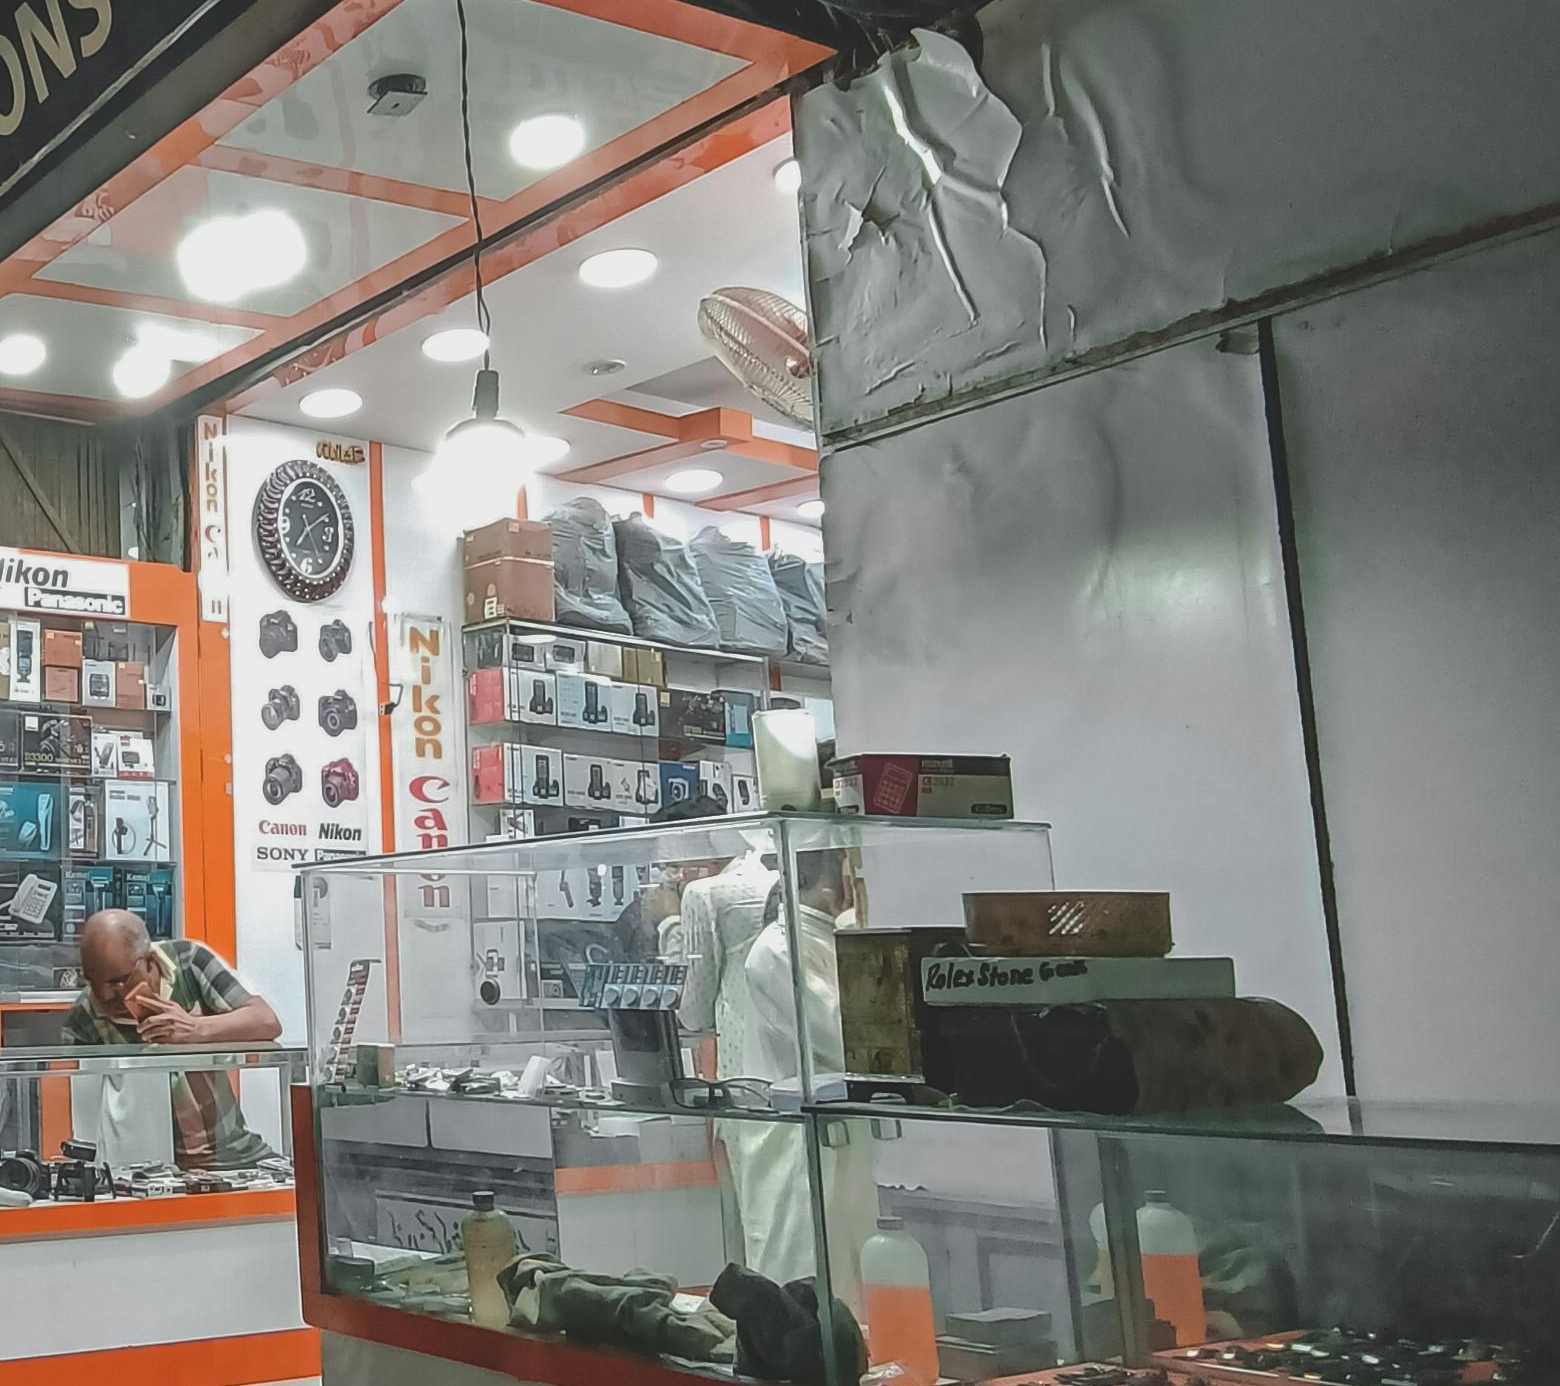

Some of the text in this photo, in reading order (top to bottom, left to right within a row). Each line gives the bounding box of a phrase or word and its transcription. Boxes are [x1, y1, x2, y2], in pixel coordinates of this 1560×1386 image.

[203, 421, 218, 513] Nikon
[298, 488, 316, 503] 12
[322, 527, 335, 543] 3
[301, 557, 313, 574] 6
[27, 588, 125, 615] Panasonic
[409, 626, 443, 759] Nikon
[258, 819, 362, 841] Canon Nikon
[257, 846, 309, 861] SONY
[977, 962, 1034, 987] Stone
